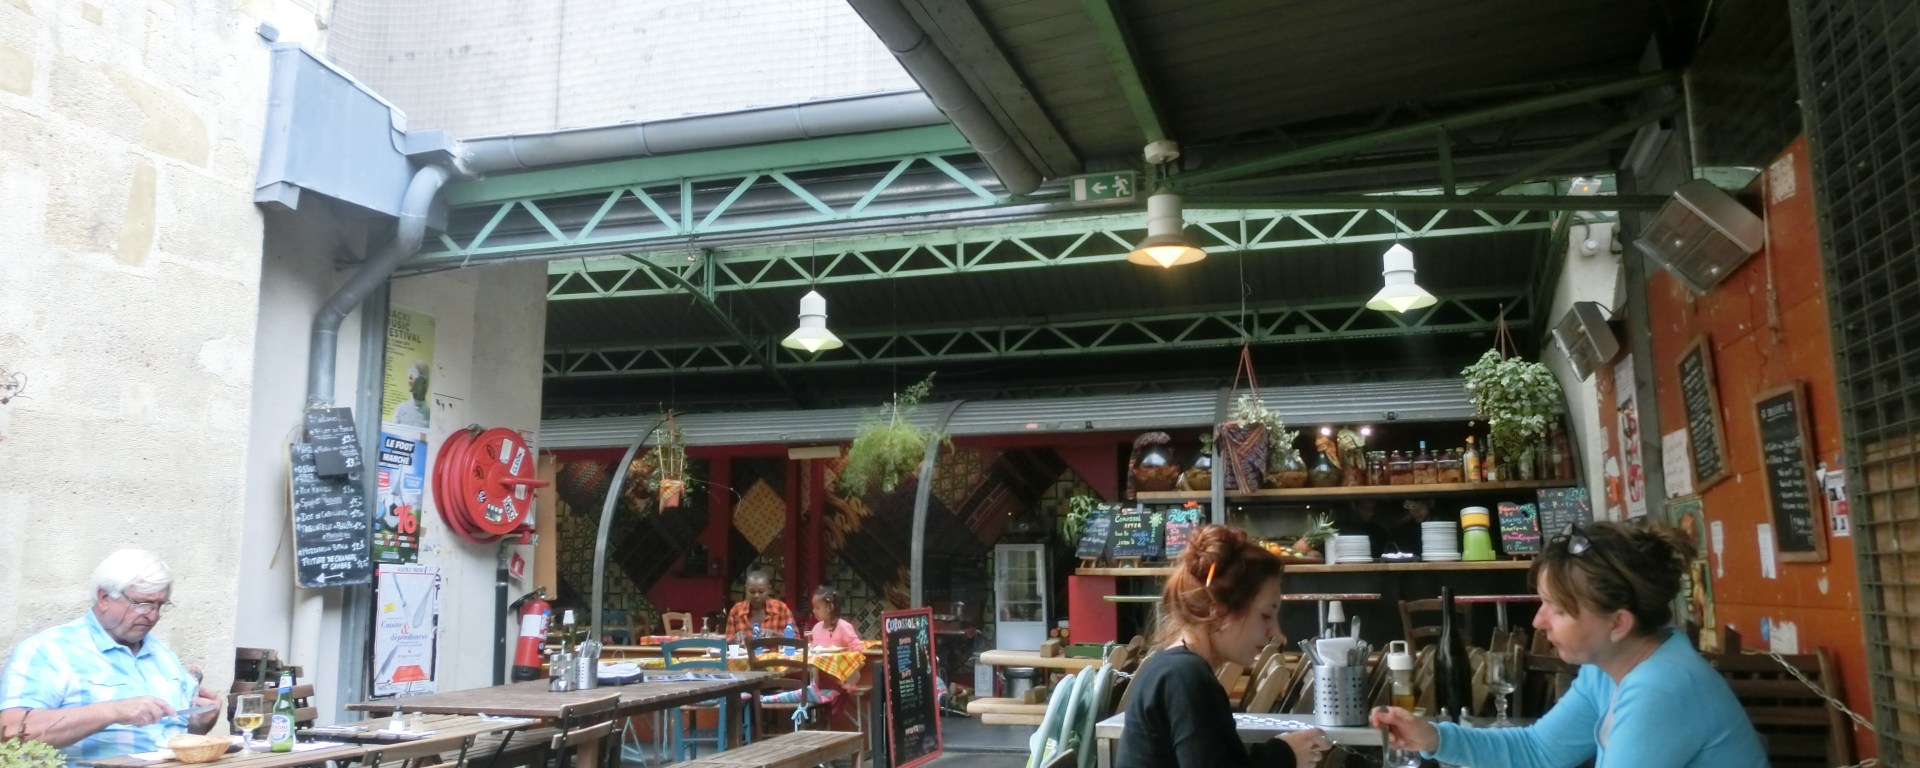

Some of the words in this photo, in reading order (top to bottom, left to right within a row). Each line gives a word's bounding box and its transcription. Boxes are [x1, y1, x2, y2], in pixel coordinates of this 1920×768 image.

[391, 319, 411, 331] USIC
[389, 327, 422, 344] ESTIVAL
[386, 438, 395, 448] LE
[395, 440, 414, 452] FOOT
